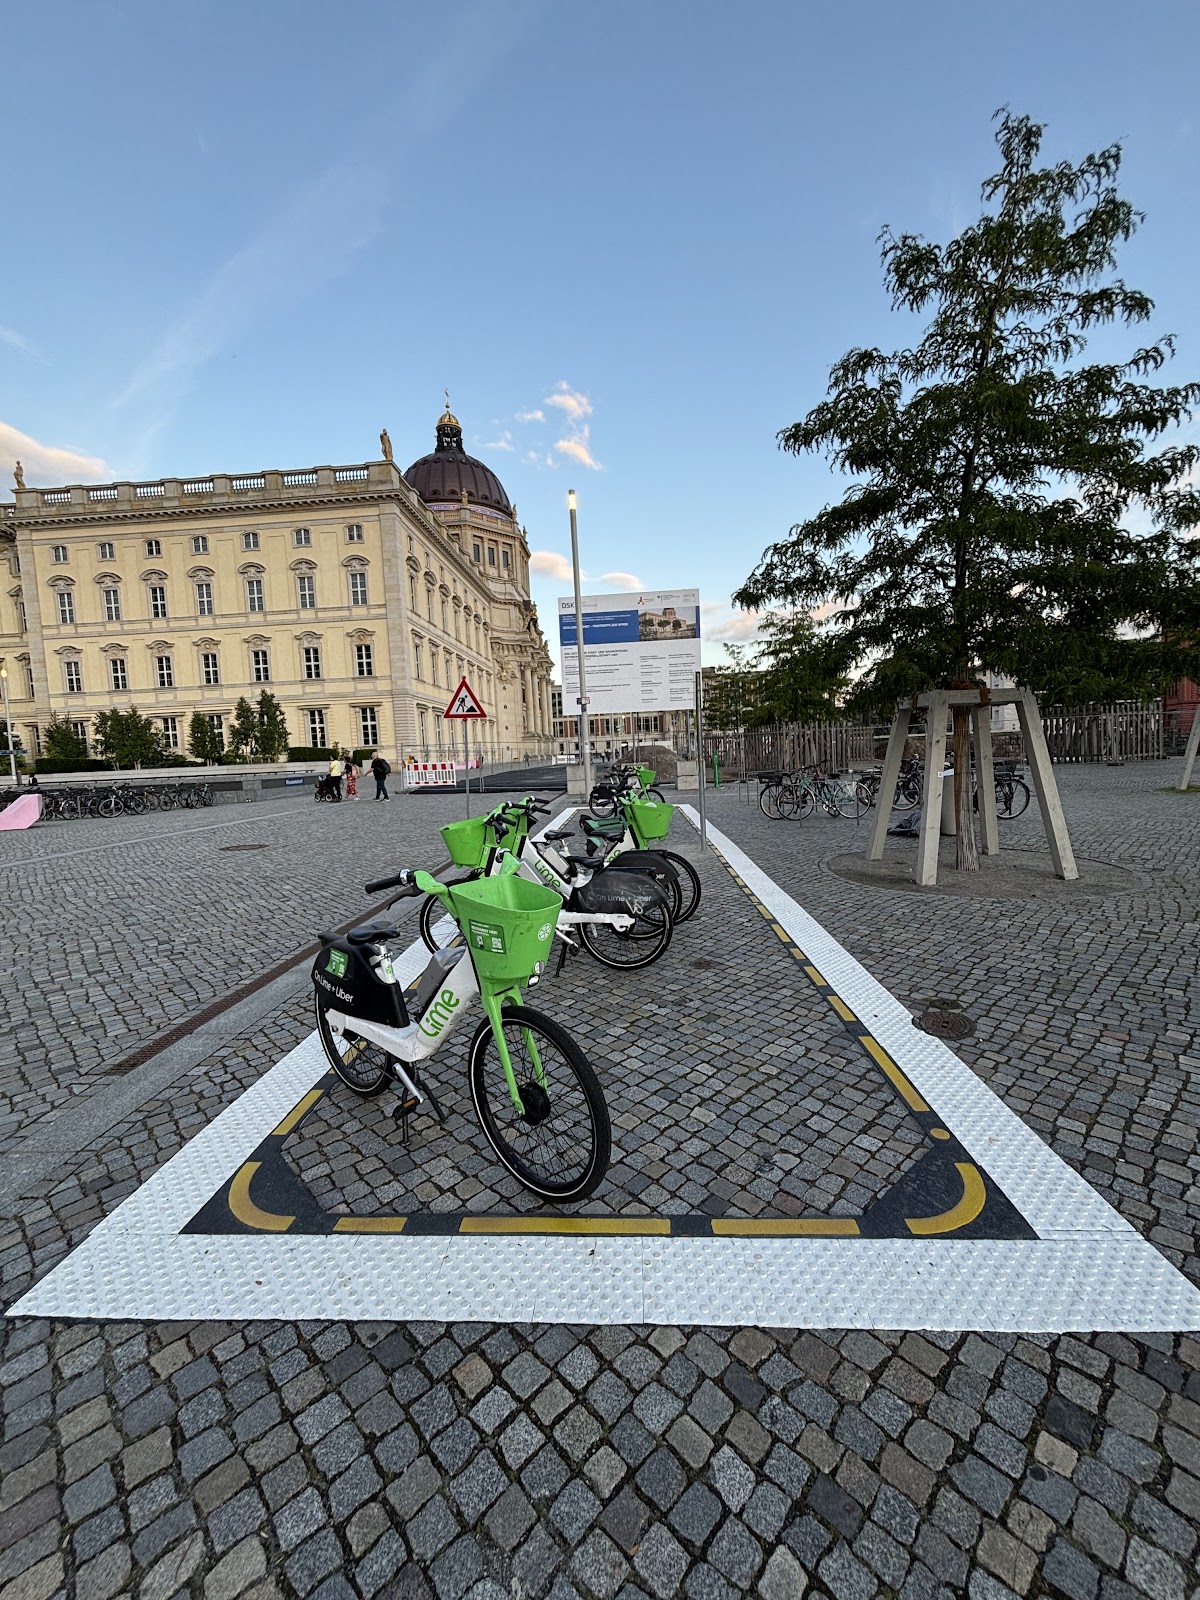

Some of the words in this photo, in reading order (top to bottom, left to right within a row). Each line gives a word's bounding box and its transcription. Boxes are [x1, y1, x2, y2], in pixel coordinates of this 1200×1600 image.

[534, 860, 560, 887] Lime
[320, 976, 331, 991] Lime
[336, 986, 354, 1003] Uber
[419, 990, 460, 1037] Lime
